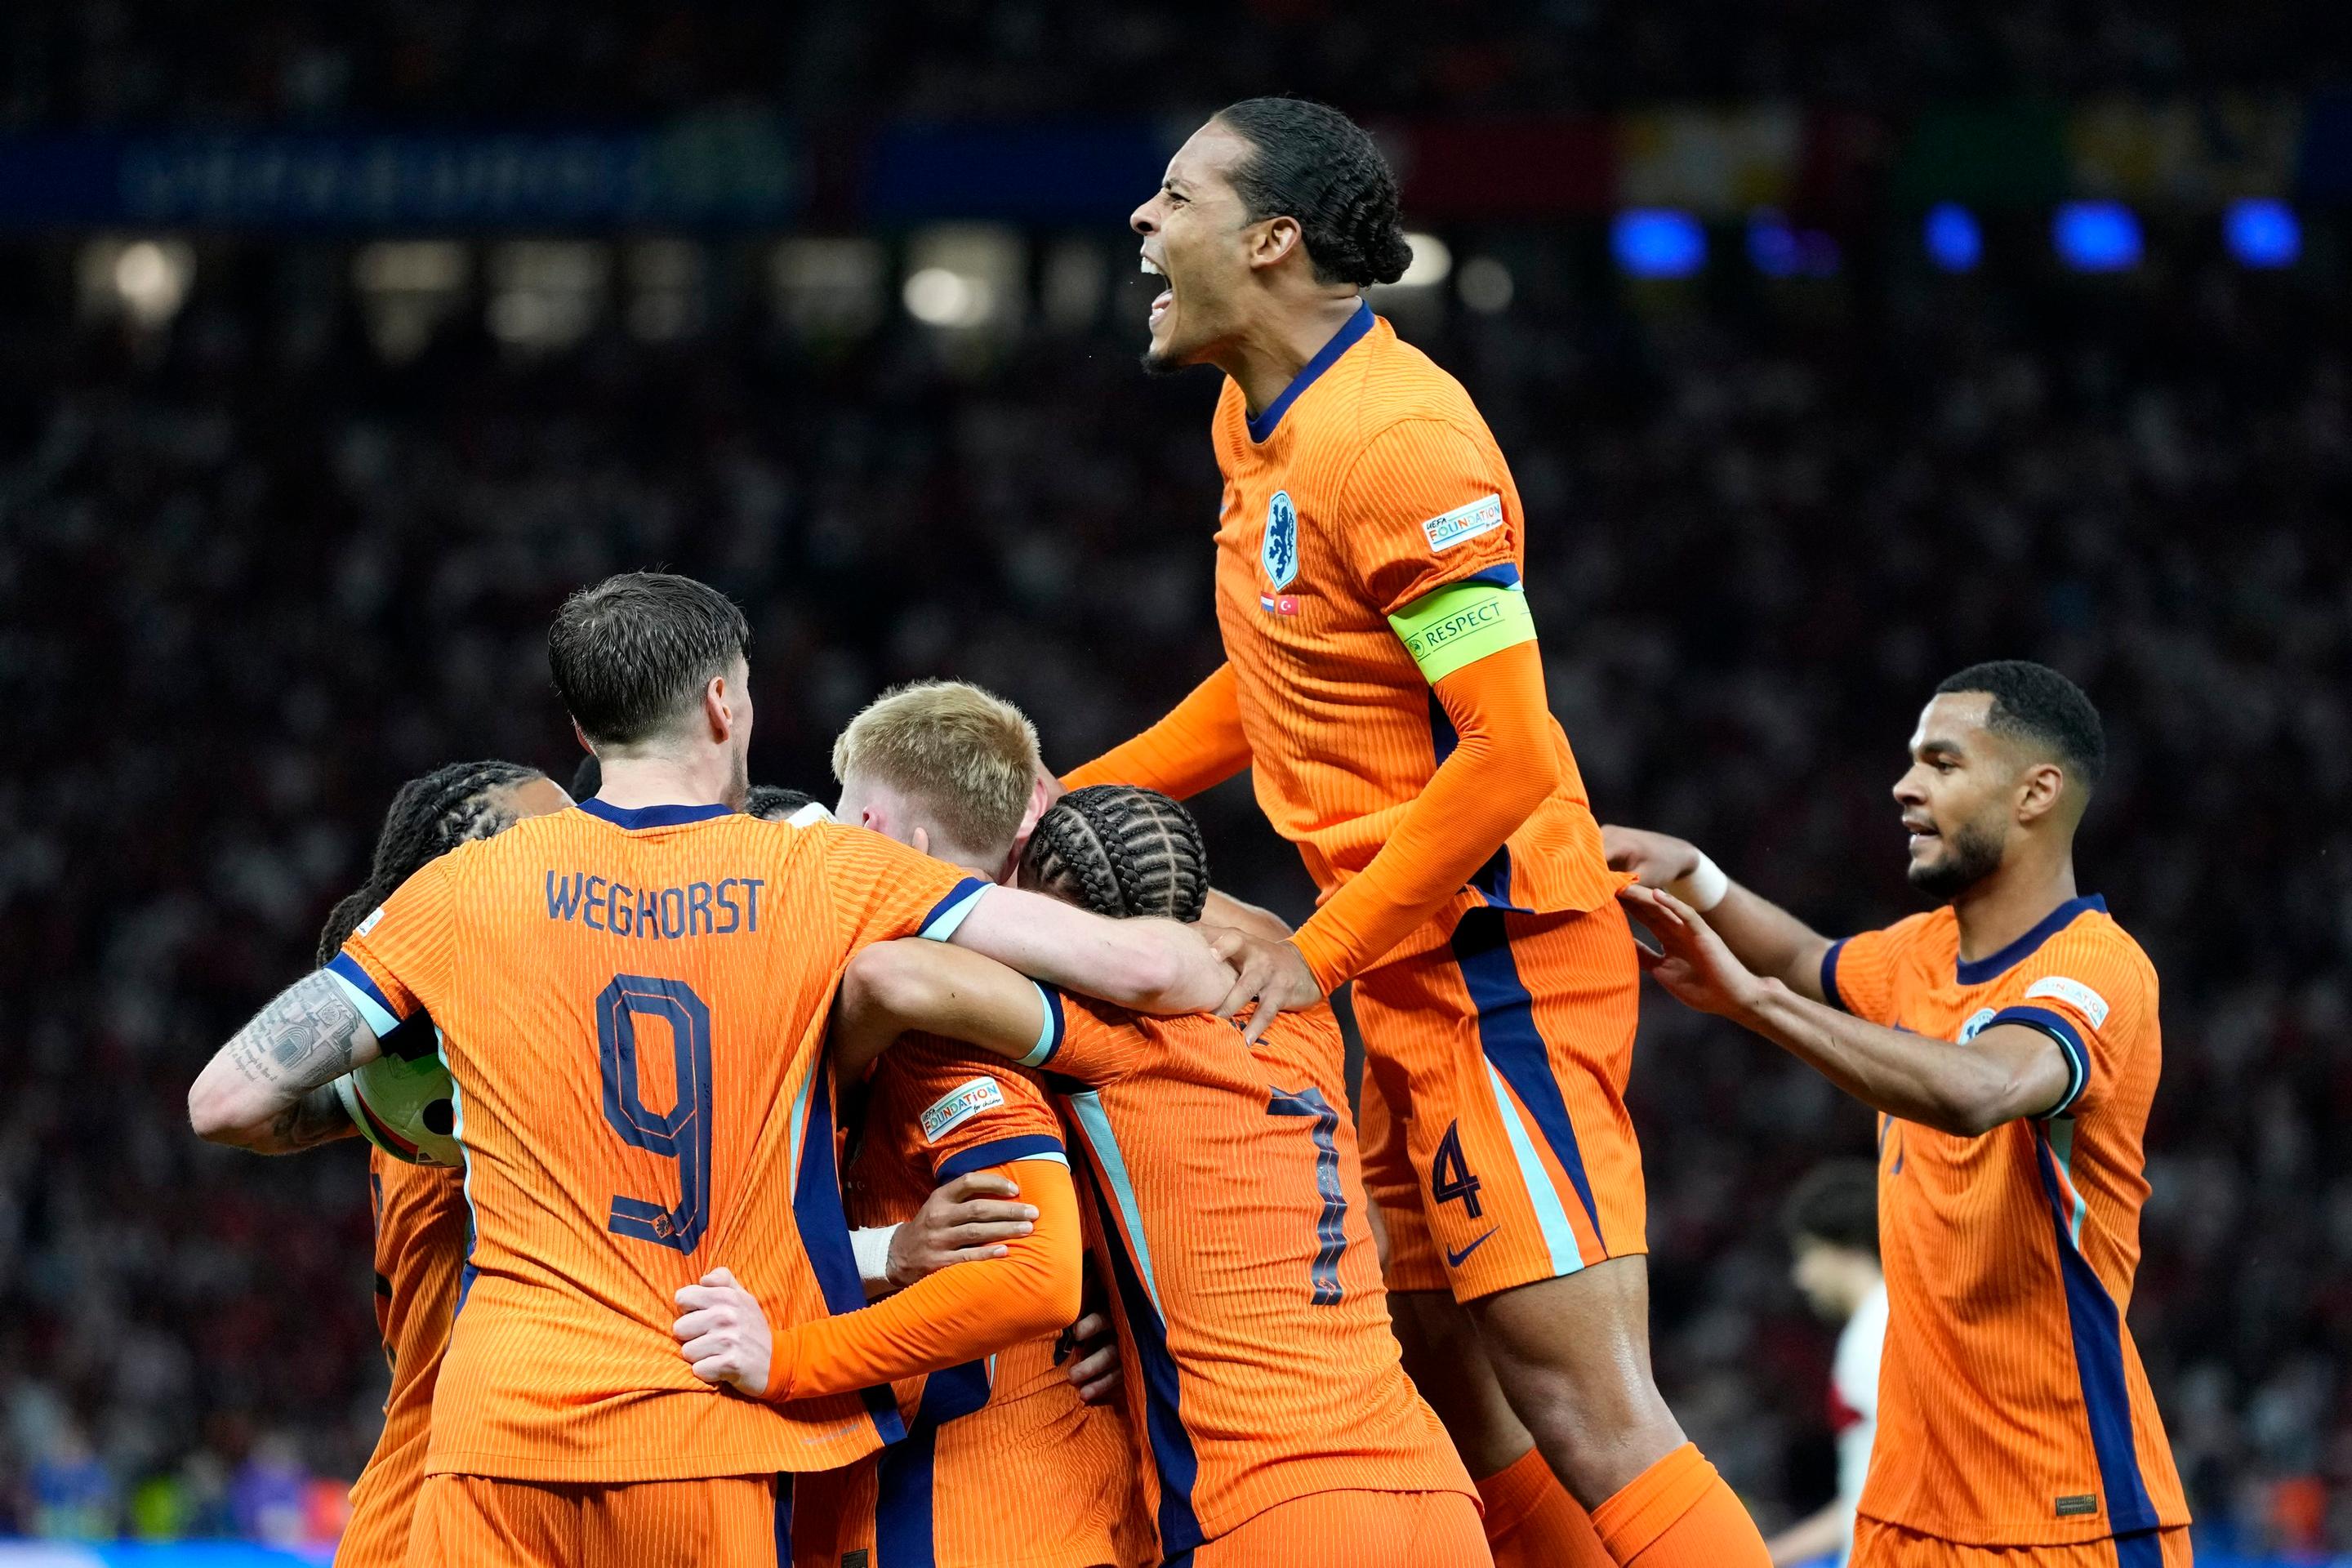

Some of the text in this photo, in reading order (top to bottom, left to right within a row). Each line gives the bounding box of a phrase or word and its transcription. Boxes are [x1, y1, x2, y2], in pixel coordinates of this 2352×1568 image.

[1427, 518, 1447, 530] UEFA
[1426, 602, 1500, 646] RESPECT
[546, 870, 764, 940] WEGHORST
[595, 973, 712, 1255] 9
[922, 1108, 938, 1123] UEFA
[1432, 1117, 1482, 1219] 4
